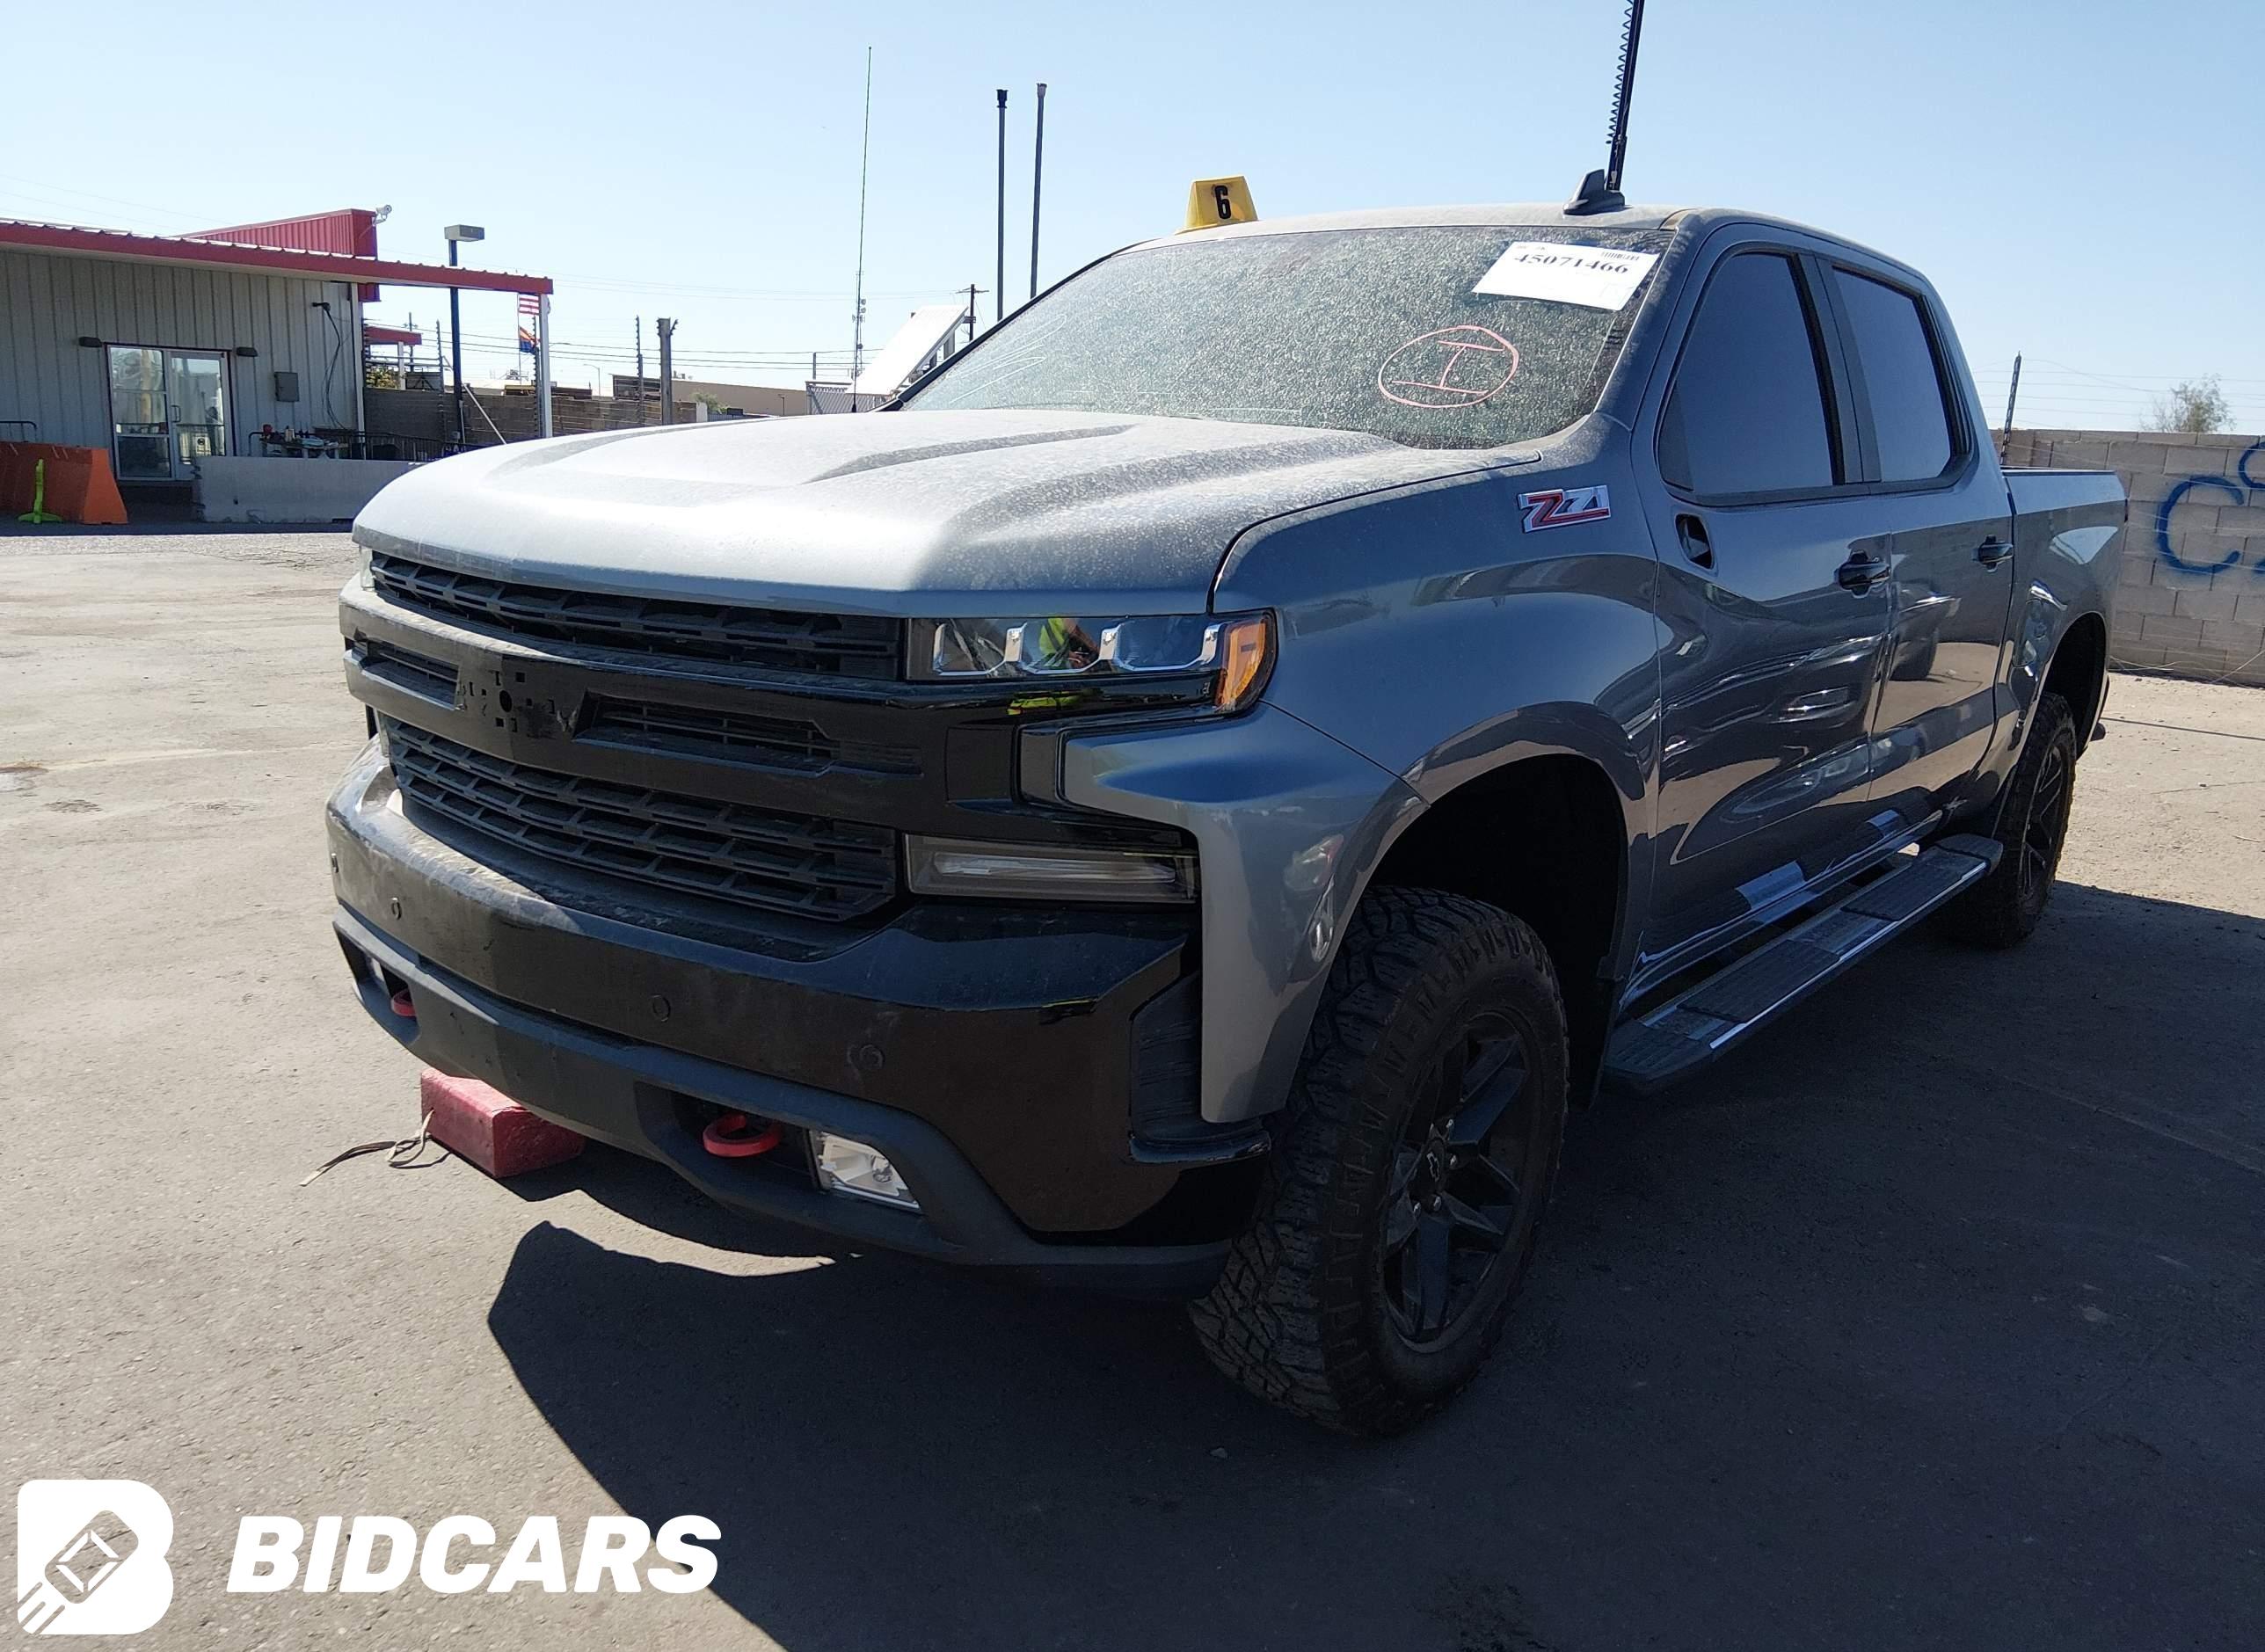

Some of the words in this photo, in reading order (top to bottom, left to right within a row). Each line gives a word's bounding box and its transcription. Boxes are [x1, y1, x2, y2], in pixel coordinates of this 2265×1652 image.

[1214, 185, 1232, 220] 6
[1513, 252, 1632, 275] 45071466
[1518, 484, 1612, 534] Z71
